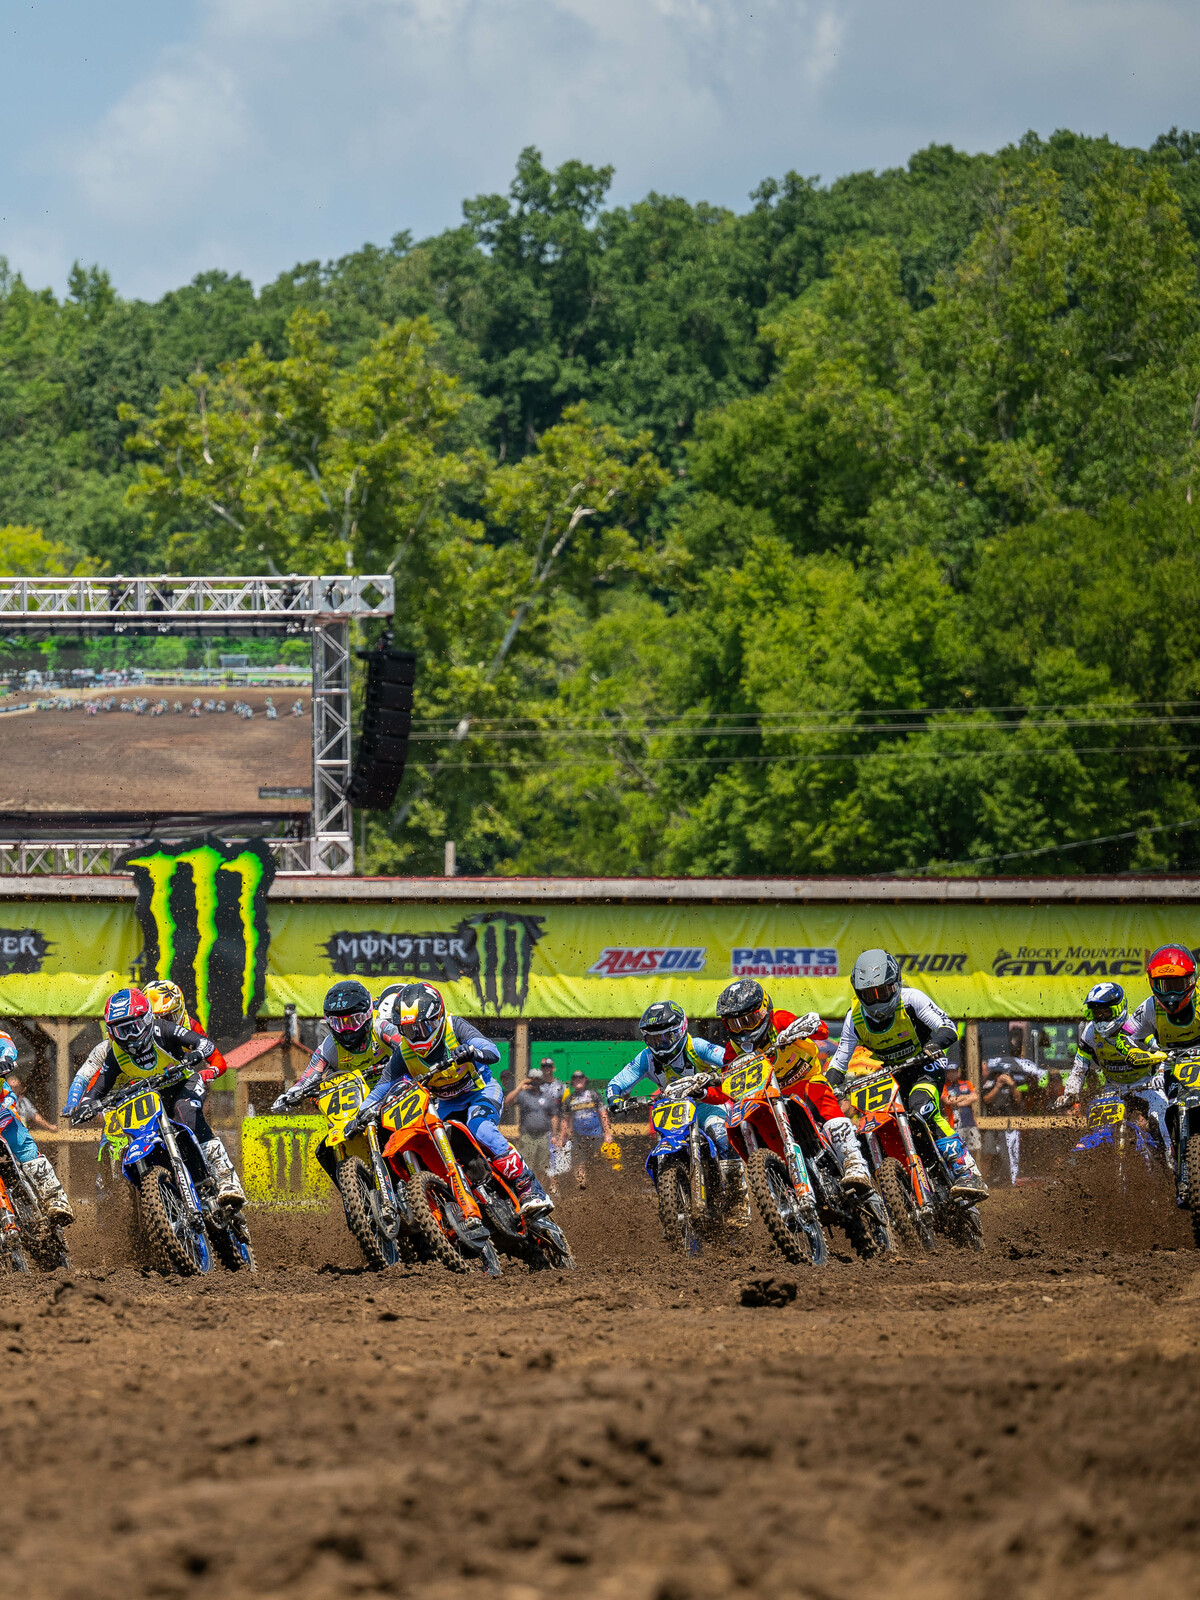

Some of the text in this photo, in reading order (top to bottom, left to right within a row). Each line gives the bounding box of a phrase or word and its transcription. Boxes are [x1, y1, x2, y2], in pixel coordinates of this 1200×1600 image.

[337, 935, 468, 959] MONSTER
[732, 948, 837, 965] PARTS
[1017, 946, 1142, 958] ROCKY MOUNTAIN
[355, 961, 447, 972] ENERGY
[596, 949, 705, 974] AMSOIL
[732, 965, 837, 977] UNLIMITED
[896, 954, 967, 972] THOR
[730, 1063, 764, 1099] 93
[327, 1088, 362, 1116] 43
[855, 1080, 893, 1114] 15
[117, 1094, 157, 1129] 70
[389, 1094, 423, 1131] 12
[654, 1103, 688, 1128] 79
